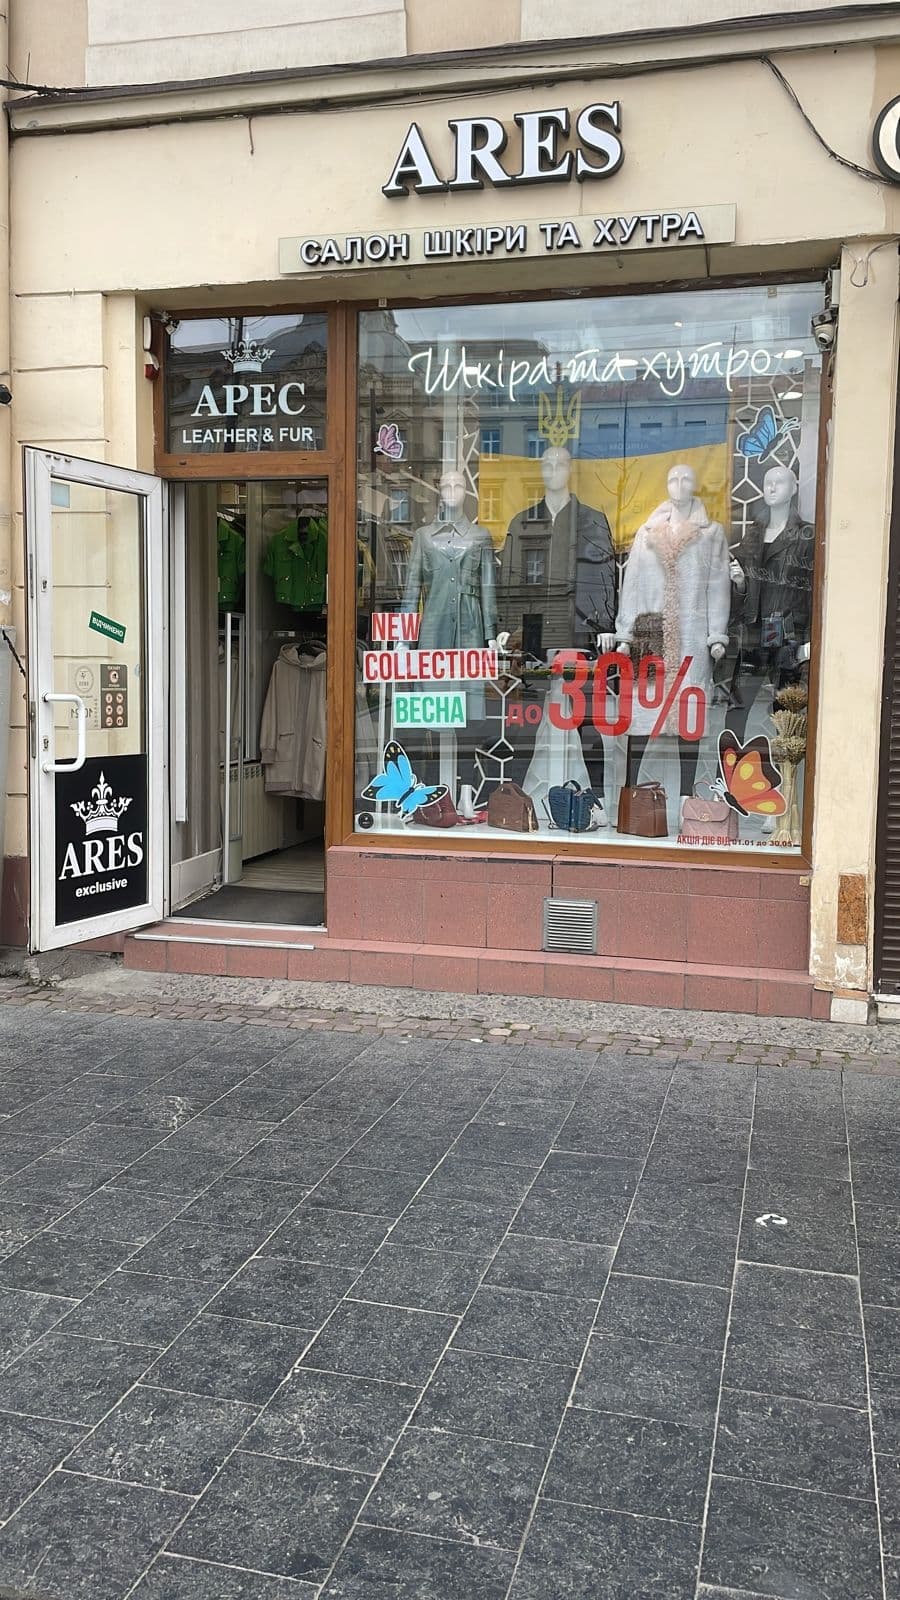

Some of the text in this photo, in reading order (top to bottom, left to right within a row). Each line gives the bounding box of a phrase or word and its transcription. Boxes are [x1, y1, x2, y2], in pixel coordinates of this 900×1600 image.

[382, 101, 624, 197] ARES
[299, 211, 705, 266] САЛОН ШКІРИ ТА ХУТРА
[408, 342, 771, 402] Шкіра та хутро
[182, 426, 314, 444] LEATHER & FUR
[372, 613, 420, 641] NEW
[365, 649, 497, 681] COLLECTION
[395, 695, 465, 724] ВЕСНА
[549, 651, 706, 742] 30%
[58, 831, 144, 880] ARES
[677, 835, 699, 845] АКЦІЯ
[75, 877, 128, 898] exclusive
